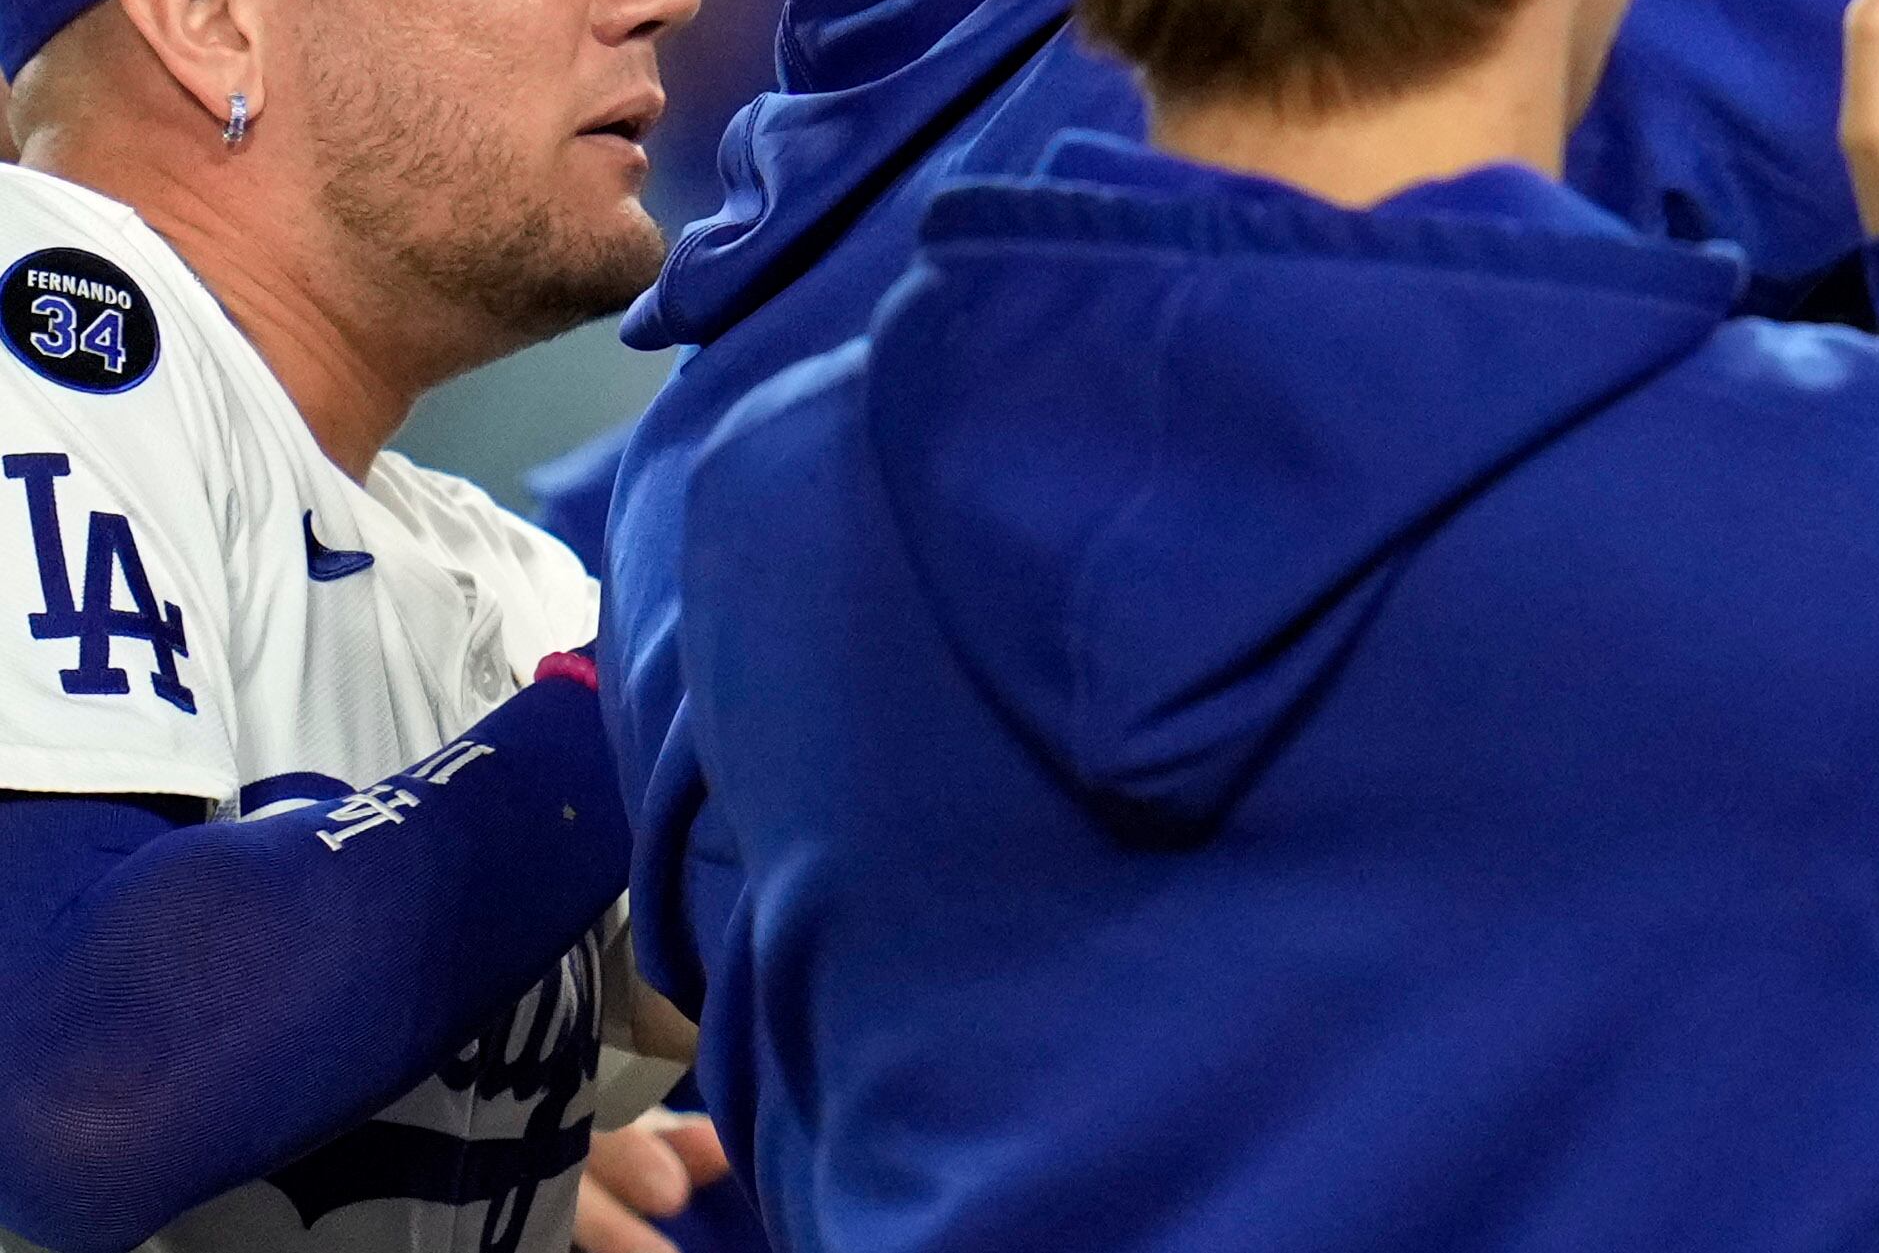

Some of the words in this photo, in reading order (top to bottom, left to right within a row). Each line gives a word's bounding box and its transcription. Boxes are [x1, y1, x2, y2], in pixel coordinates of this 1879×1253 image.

[27, 269, 132, 309] FERNANDO
[30, 295, 126, 374] 34
[2, 452, 197, 715] LA
